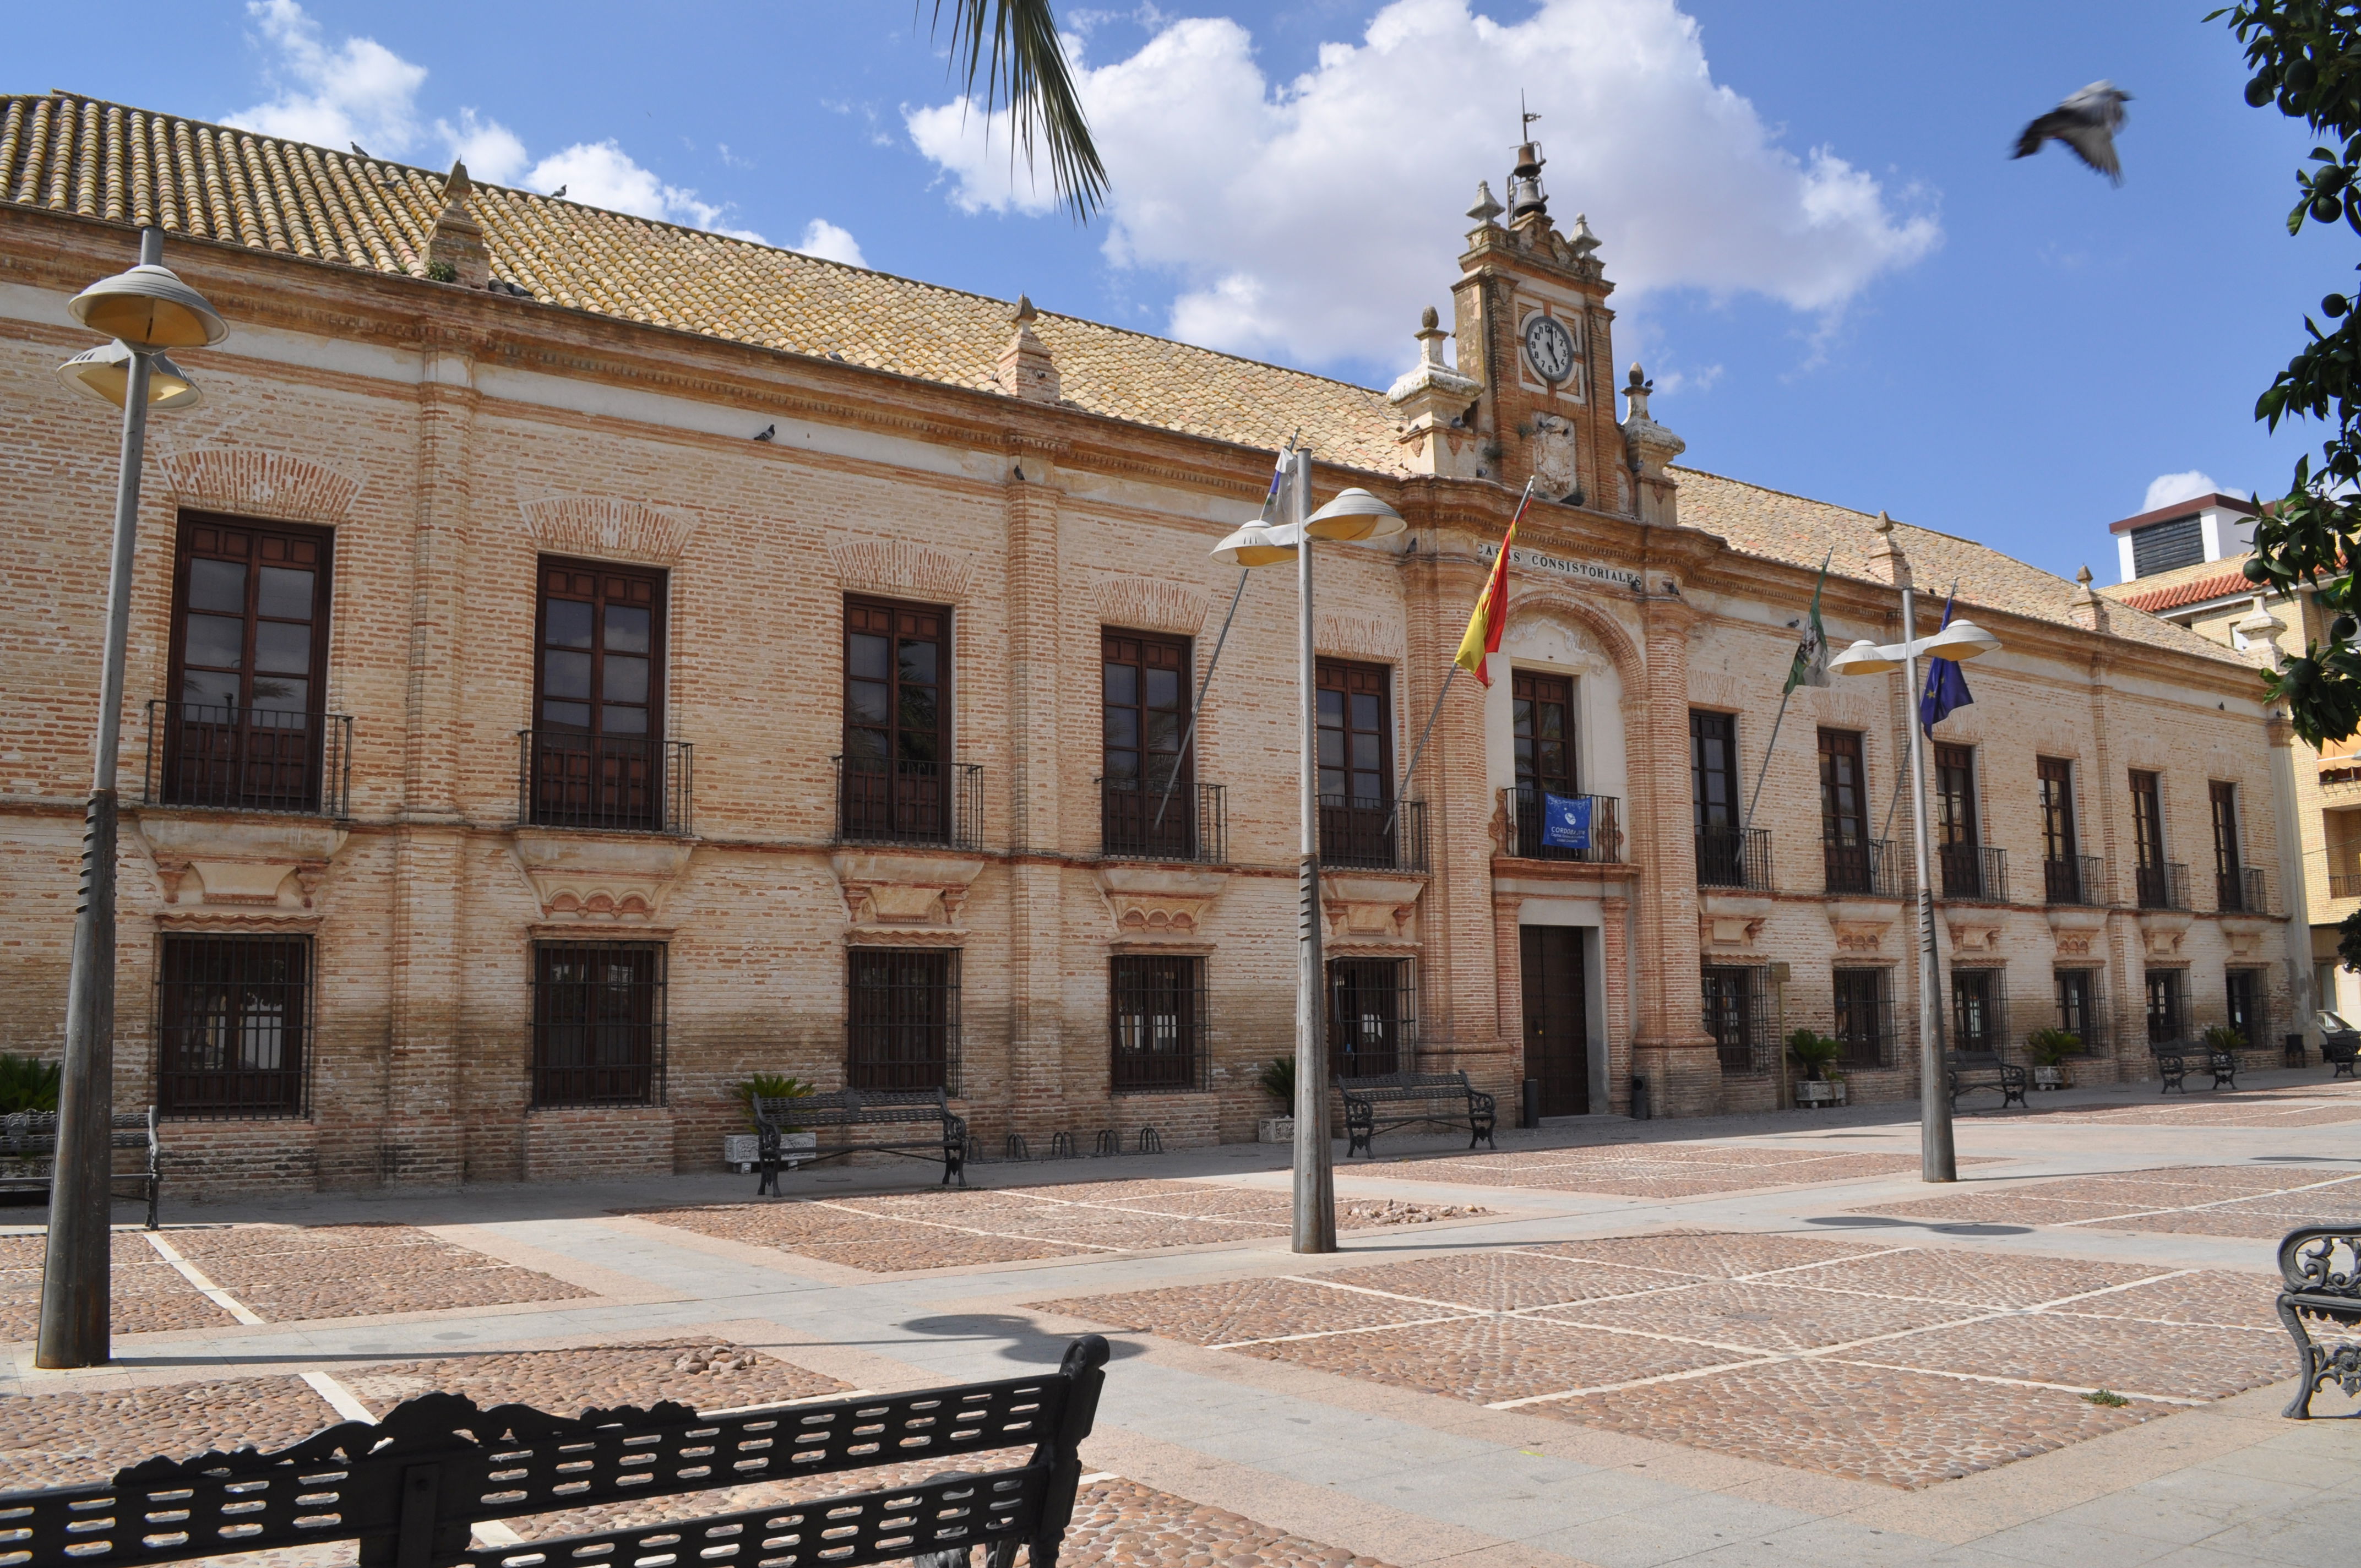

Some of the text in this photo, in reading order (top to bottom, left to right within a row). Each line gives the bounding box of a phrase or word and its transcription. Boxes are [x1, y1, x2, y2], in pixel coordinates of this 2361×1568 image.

[1538, 326, 1543, 334] 11
[1534, 332, 1540, 340] 10
[1531, 341, 1536, 349] 9
[1563, 349, 1566, 357] 3
[1478, 544, 1641, 586] CASS CONSISTORIALES
